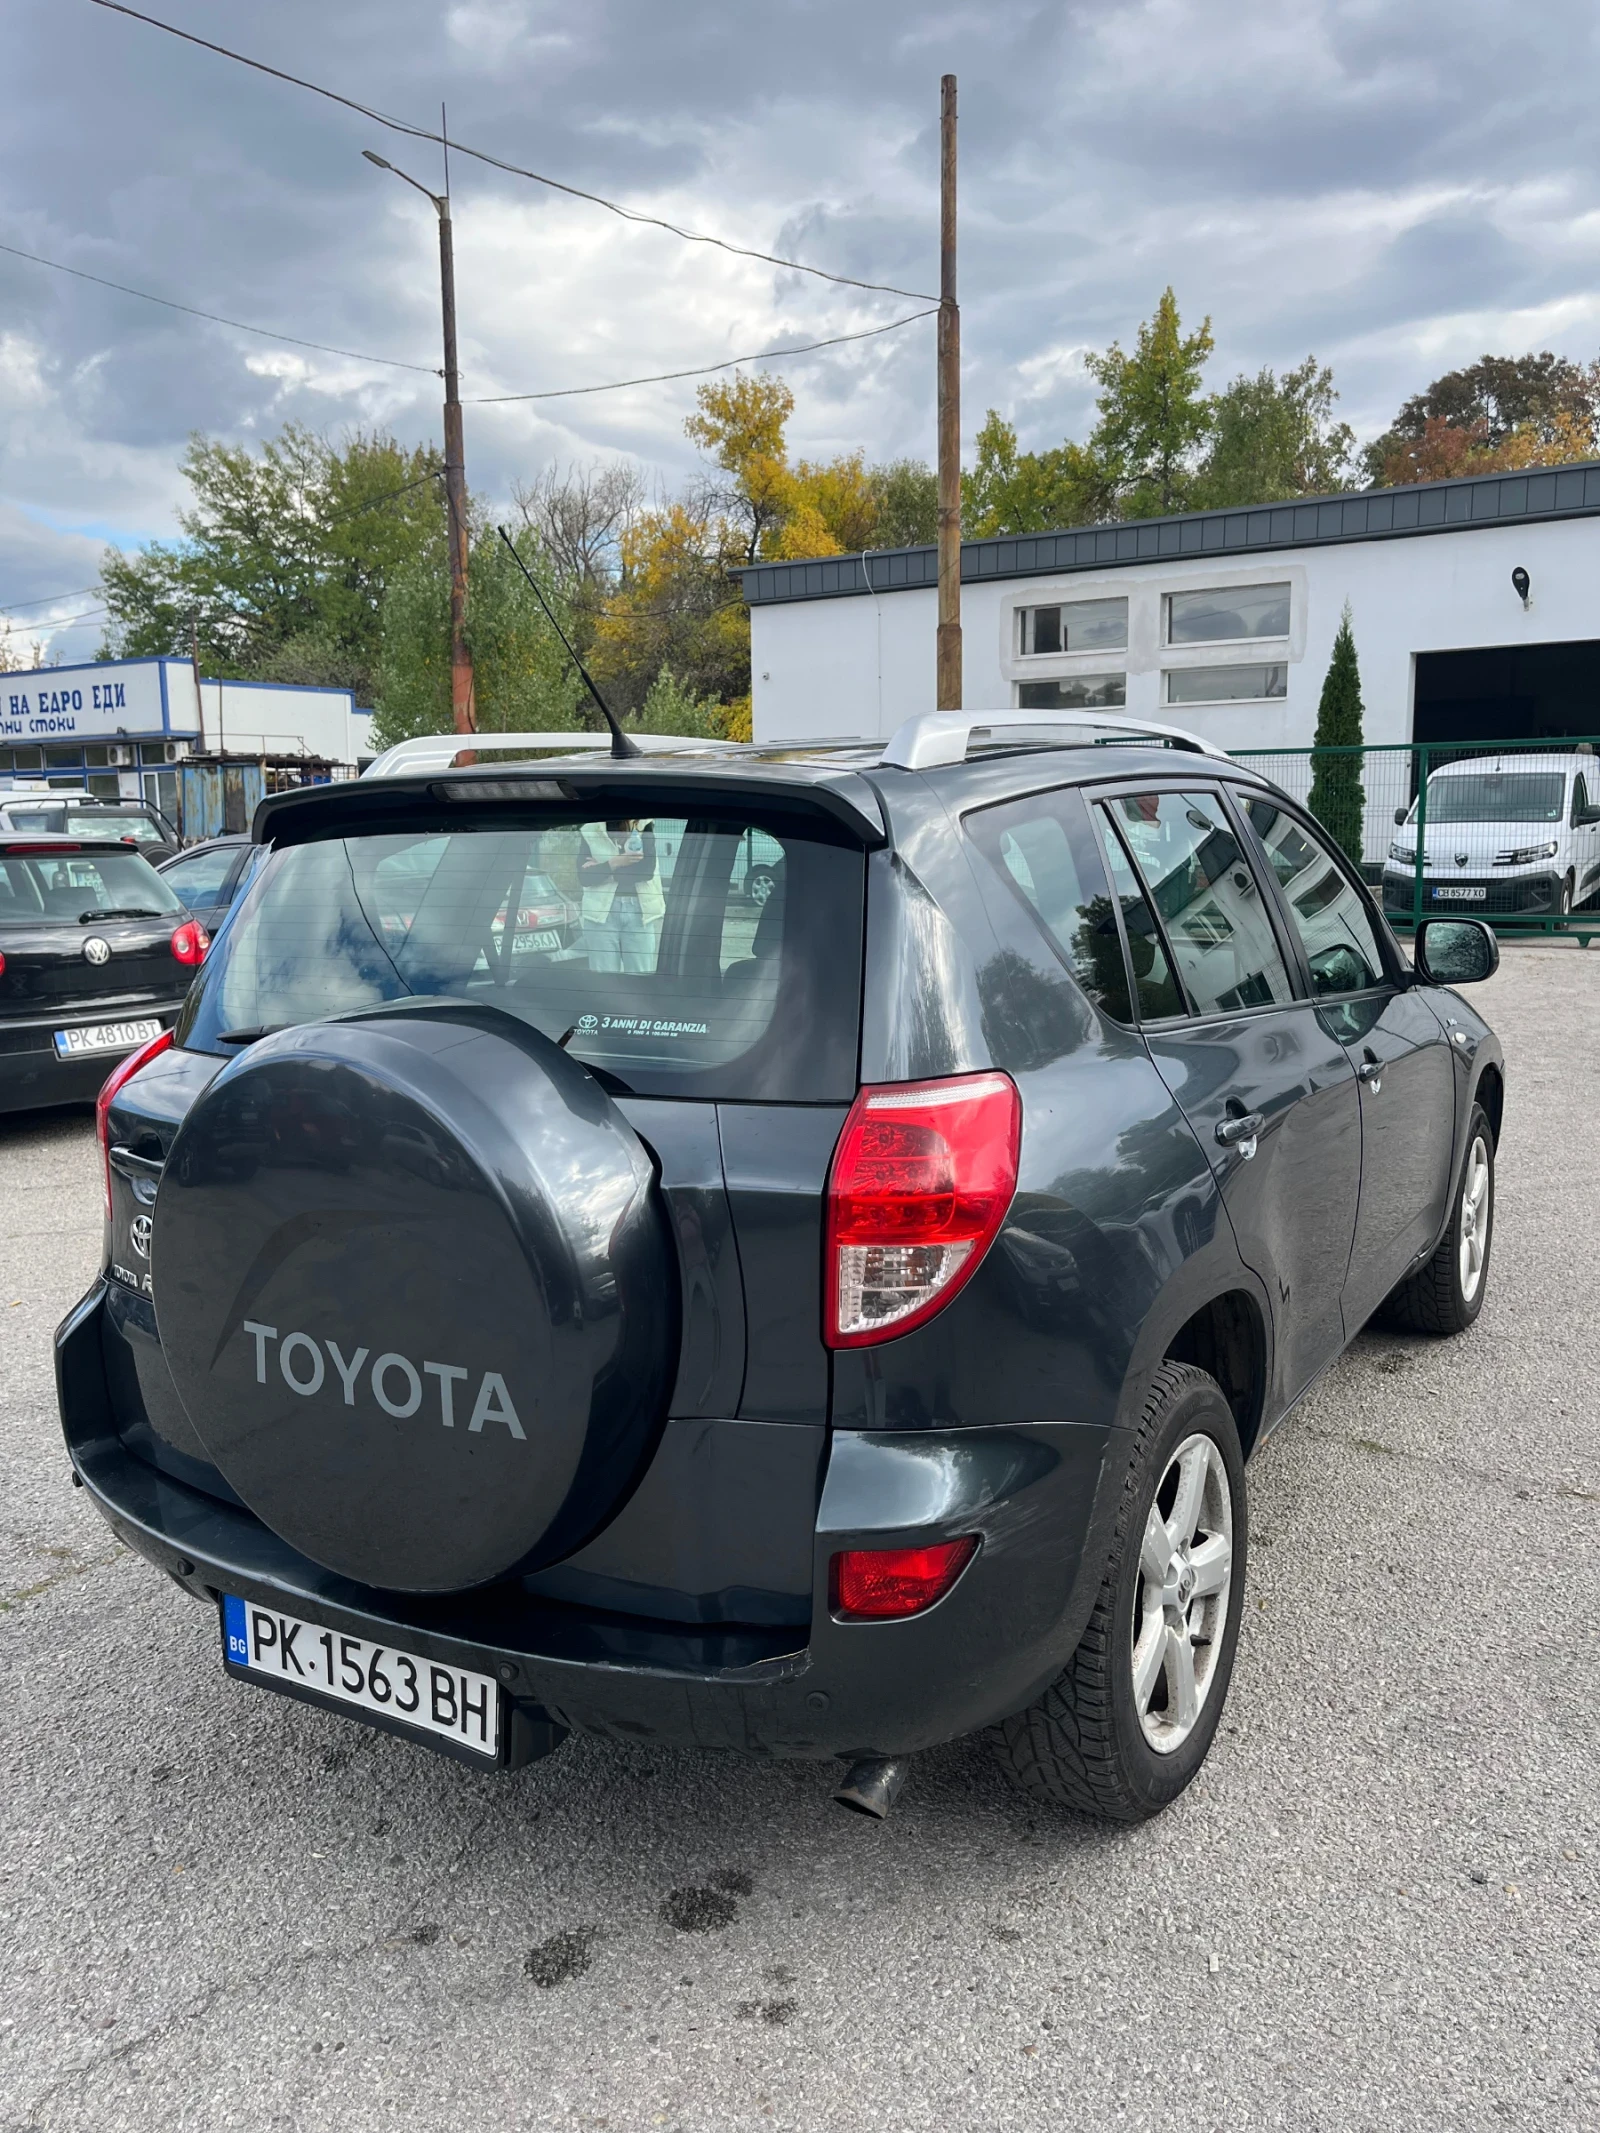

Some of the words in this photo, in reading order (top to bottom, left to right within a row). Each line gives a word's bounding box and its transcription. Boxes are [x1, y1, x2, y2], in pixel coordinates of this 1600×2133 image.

[9, 694, 30, 715] НА
[38, 689, 83, 714] ЕДРО
[92, 683, 126, 714] ЕДИ
[29, 716, 76, 733] стоки
[573, 1028, 598, 1036] TOYOTA
[601, 1017, 611, 1028] 3
[610, 1019, 637, 1029] ANNI
[639, 1020, 650, 1030] DI
[653, 1021, 707, 1033] GARANZIA
[67, 1028, 94, 1049] PK
[244, 1320, 527, 1440] TOYOTA
[229, 1634, 246, 1654] BG
[252, 1610, 306, 1676] PK
[319, 1632, 420, 1712] 1563
[430, 1666, 488, 1743] BH
